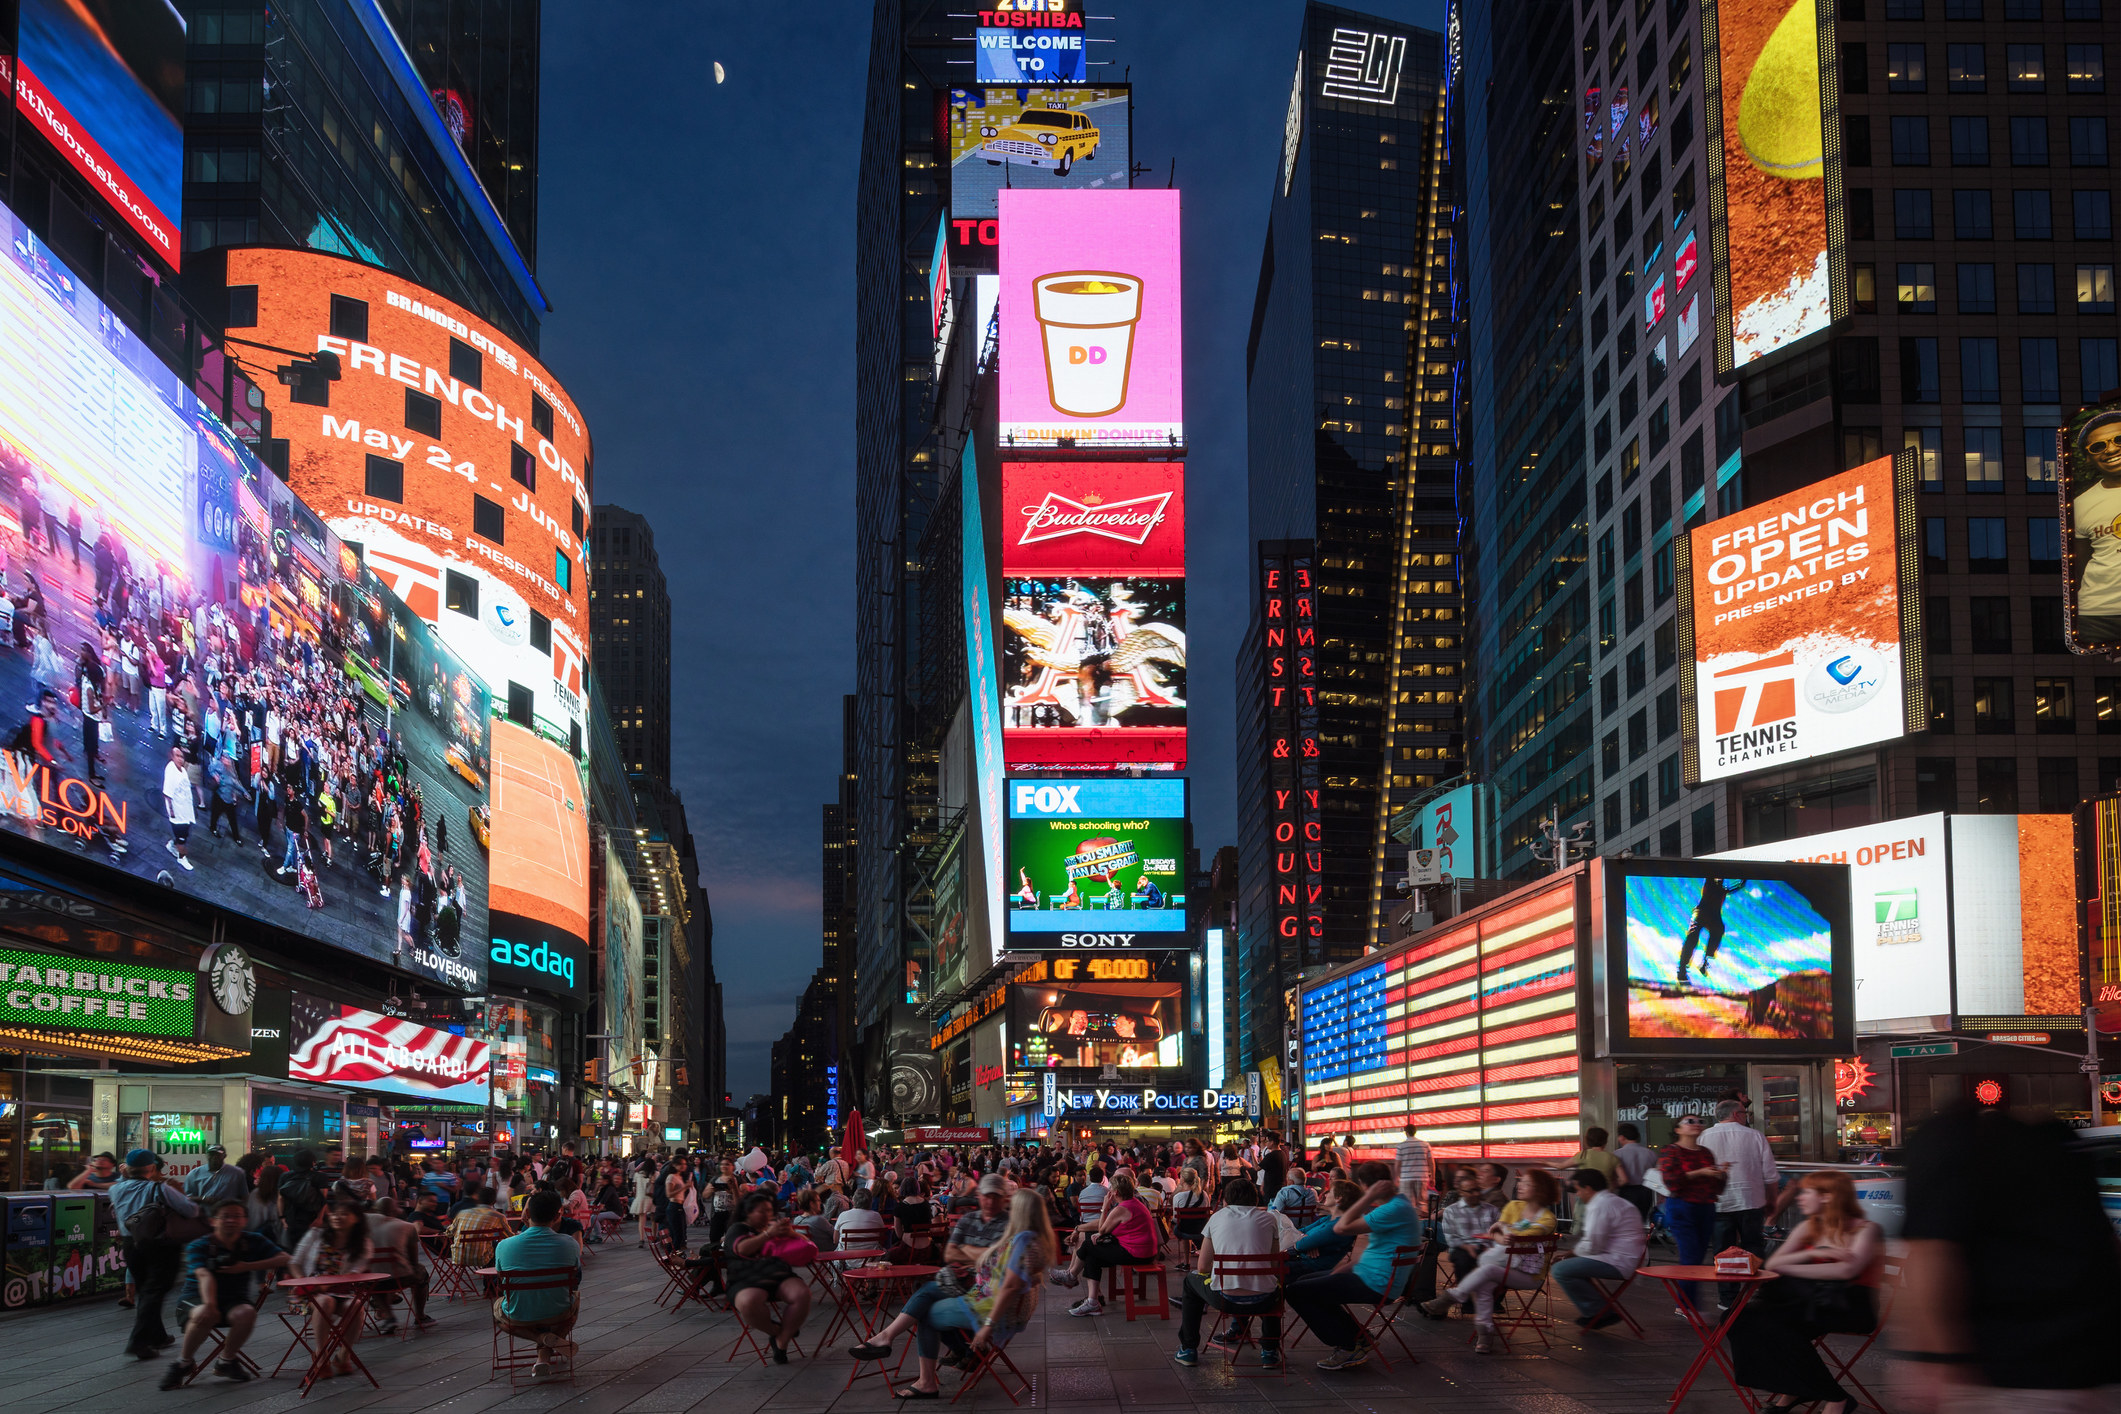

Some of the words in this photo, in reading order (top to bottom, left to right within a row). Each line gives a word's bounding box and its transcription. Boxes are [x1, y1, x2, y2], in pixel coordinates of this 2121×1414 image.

[978, 11, 1083, 28] TOSHIBA
[979, 36, 1082, 50] WELCOME
[1017, 57, 1045, 71] TO
[386, 290, 468, 339] BRANDED
[470, 329, 518, 371] CITIES
[523, 367, 581, 437] PRESENTS
[1069, 346, 1107, 364] DD
[317, 334, 524, 444] FRENCH
[538, 438, 591, 518] OPEN
[1099, 428, 1164, 441] DONUTS
[322, 414, 415, 460] May
[426, 444, 478, 484] 24
[512, 492, 571, 549] June
[576, 541, 585, 564] 7
[347, 500, 453, 541] UPDATES
[1021, 504, 1165, 529] Budweiser
[1710, 484, 1866, 556] FRENCH
[1706, 507, 1869, 586] OPEN
[466, 537, 560, 601] PRESENTED
[564, 598, 578, 619] BY
[1713, 541, 1870, 606] UPDATES
[1714, 579, 1834, 626] PRESENTED
[1841, 566, 1871, 586] BY
[971, 585, 984, 679] SCORE
[1267, 570, 1285, 708] ERNST
[553, 679, 581, 714] TENNIS
[1825, 689, 1867, 706] MEDIA
[979, 675, 992, 767] GREAT
[1272, 738, 1290, 759] &
[1715, 720, 1798, 756] TENNIS
[1717, 740, 1798, 767] CHANNEL
[2, 748, 127, 835] VLON
[1016, 785, 1081, 813] FOX
[37, 805, 58, 827] IS
[61, 816, 93, 841] ON
[987, 769, 1003, 902] SAVINGS
[1050, 821, 1077, 830] Who's
[1079, 821, 1121, 831] schooling
[1122, 820, 1150, 830] who?
[1078, 853, 1096, 864] YOU
[1274, 789, 1298, 938] YOUNG
[1856, 837, 1926, 867] OPEN
[1089, 865, 1099, 876] A
[1061, 933, 1136, 948] SONY
[1876, 918, 1920, 933] TENNIS
[414, 947, 478, 985] #LOVEISON
[490, 938, 575, 988] asdaq
[1054, 958, 1081, 980] OF
[0, 962, 190, 1001] TARBUCKS
[6, 989, 148, 1021] COFFEE
[332, 1031, 374, 1064] ALL
[384, 1042, 468, 1081] ABOARD!
[1920, 1047, 1937, 1055] Av
[1046, 1074, 1054, 1116] NYPD
[1057, 1089, 1094, 1109] NEW
[1096, 1089, 1139, 1110] YORK
[1143, 1089, 1199, 1110] POLICE
[1250, 1073, 1258, 1116] NYPD
[1631, 1082, 1655, 1094] U.S.
[1657, 1082, 1692, 1094] ARMED
[1693, 1082, 1729, 1094] FORCES
[170, 1131, 201, 1141] ATM
[924, 1129, 982, 1142] Walgreens
[68, 1233, 85, 1241] PAPER
